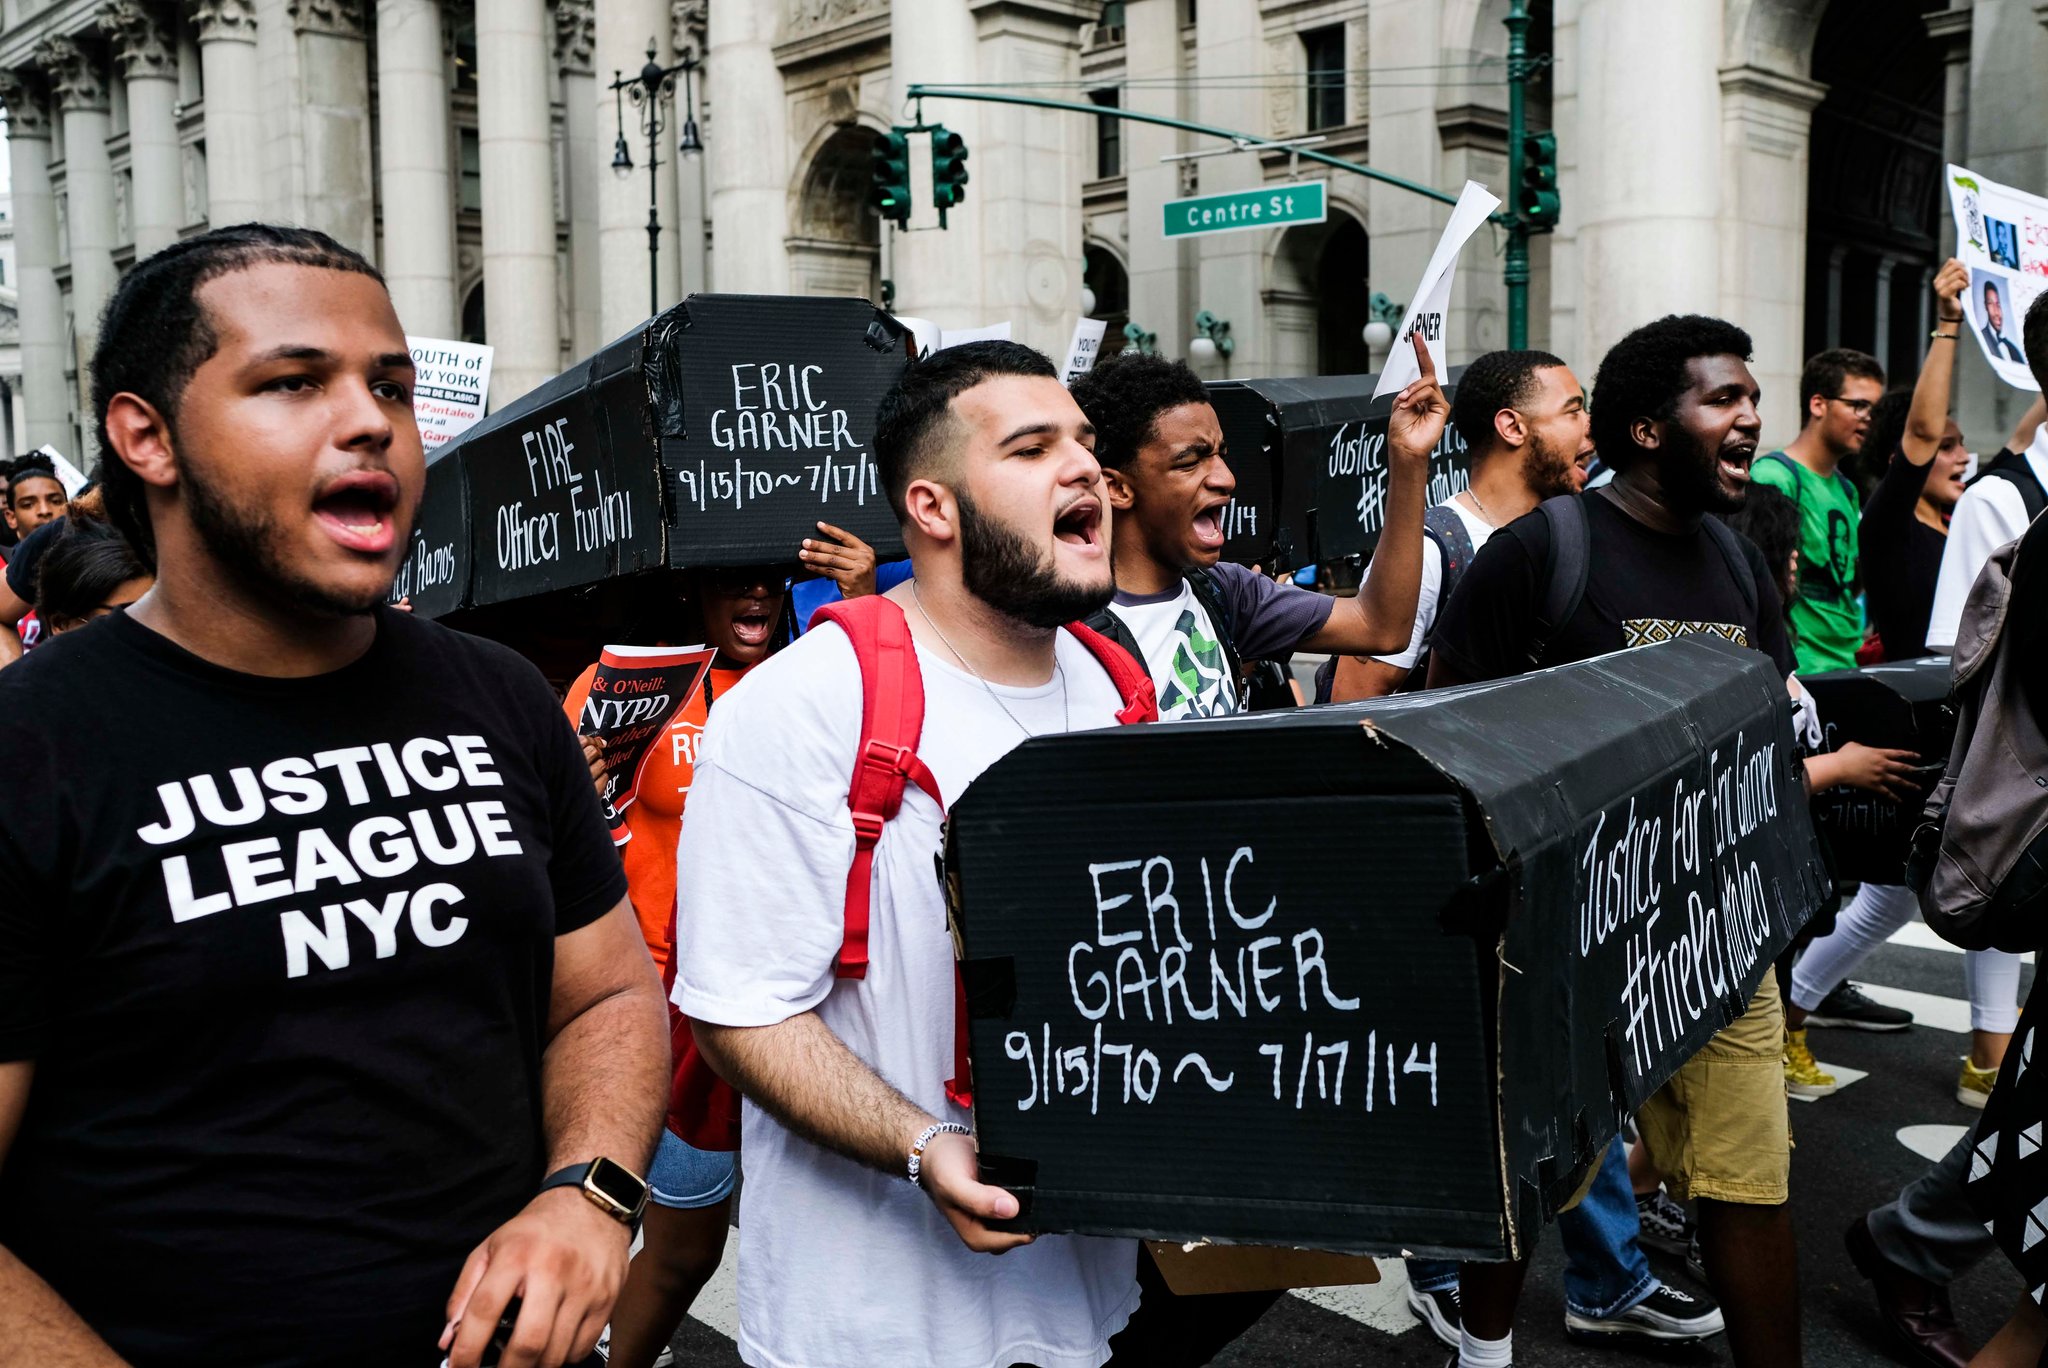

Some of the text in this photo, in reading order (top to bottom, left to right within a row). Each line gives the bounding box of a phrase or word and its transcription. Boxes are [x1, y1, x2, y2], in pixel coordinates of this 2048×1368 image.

[1187, 195, 1294, 226] Centre St
[410, 348, 483, 370] OUTH of
[438, 371, 480, 389] YORK
[415, 402, 475, 419] ePantaleo
[432, 388, 444, 399] DE
[444, 389, 477, 404] BLASIO:
[732, 363, 827, 411] ERIC
[435, 418, 447, 426] all
[711, 409, 864, 451] GARNER
[522, 417, 582, 497] FIRE
[1328, 422, 1384, 477] Justice
[804, 452, 878, 505] 7/17/1
[498, 501, 559, 570] Officer
[416, 538, 455, 595] Ramos
[581, 694, 670, 729] NYPD
[593, 676, 665, 694] & O'Neill:
[602, 747, 635, 769] illed
[137, 734, 504, 845] JUSTICE
[161, 800, 523, 923] LEAGUE
[1581, 797, 1661, 957] Justice
[1710, 749, 1736, 857] Eric
[1736, 731, 1776, 837] Garner
[1089, 846, 1276, 953] ERIC
[280, 882, 469, 979] NYC
[1068, 928, 1360, 1024] GARNER
[1005, 1022, 1161, 1115] 9/15/70
[1259, 1030, 1437, 1112] 7/17/14
